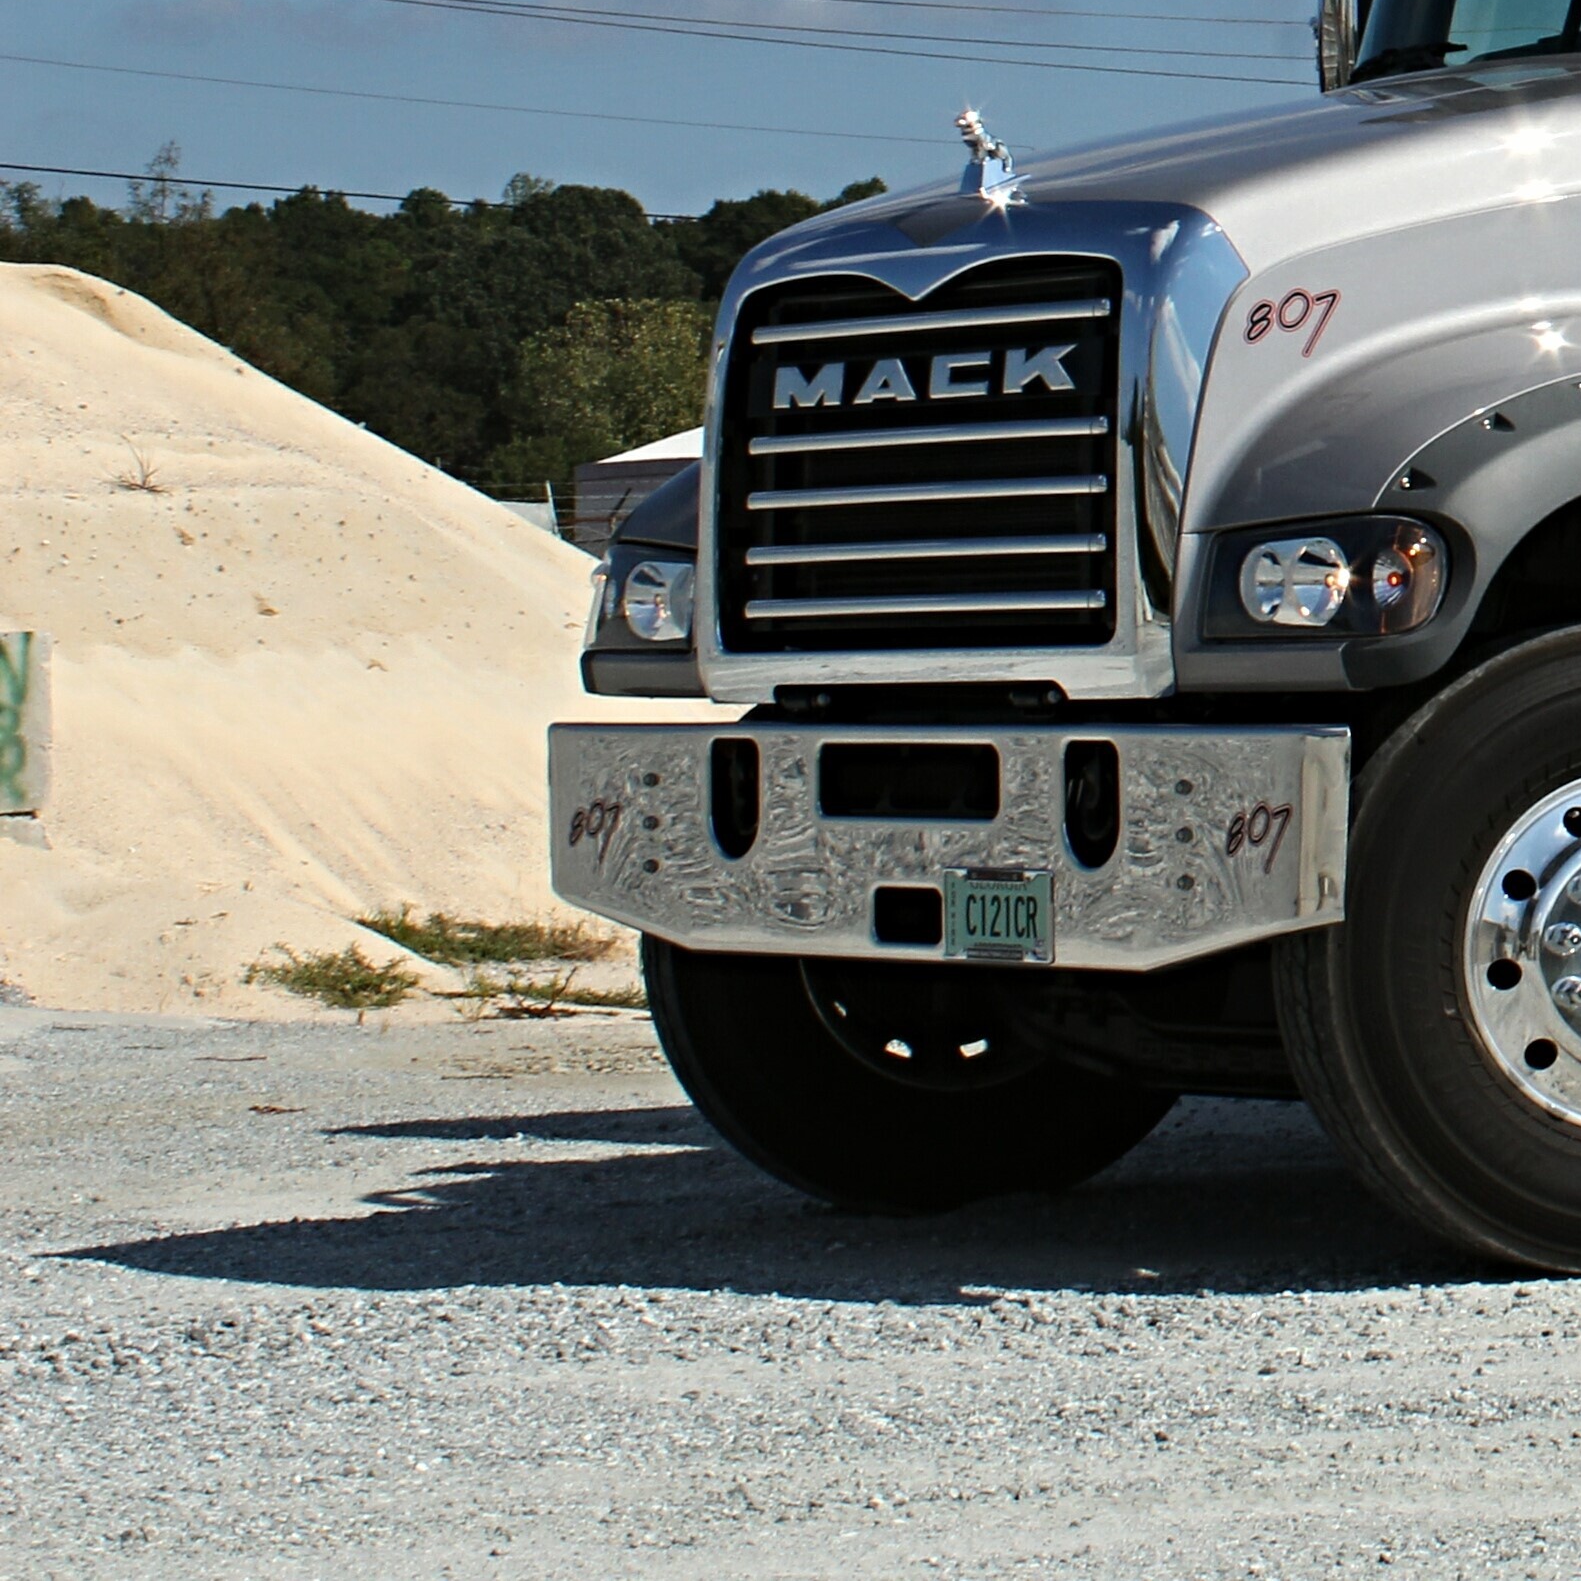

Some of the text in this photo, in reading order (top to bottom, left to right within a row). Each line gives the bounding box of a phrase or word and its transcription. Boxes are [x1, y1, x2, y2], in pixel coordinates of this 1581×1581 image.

[1243, 289, 1341, 358] 807
[772, 343, 1081, 409] MACK
[567, 798, 622, 865] 807
[1227, 802, 1293, 875] 807
[965, 893, 1038, 939] C121CR
